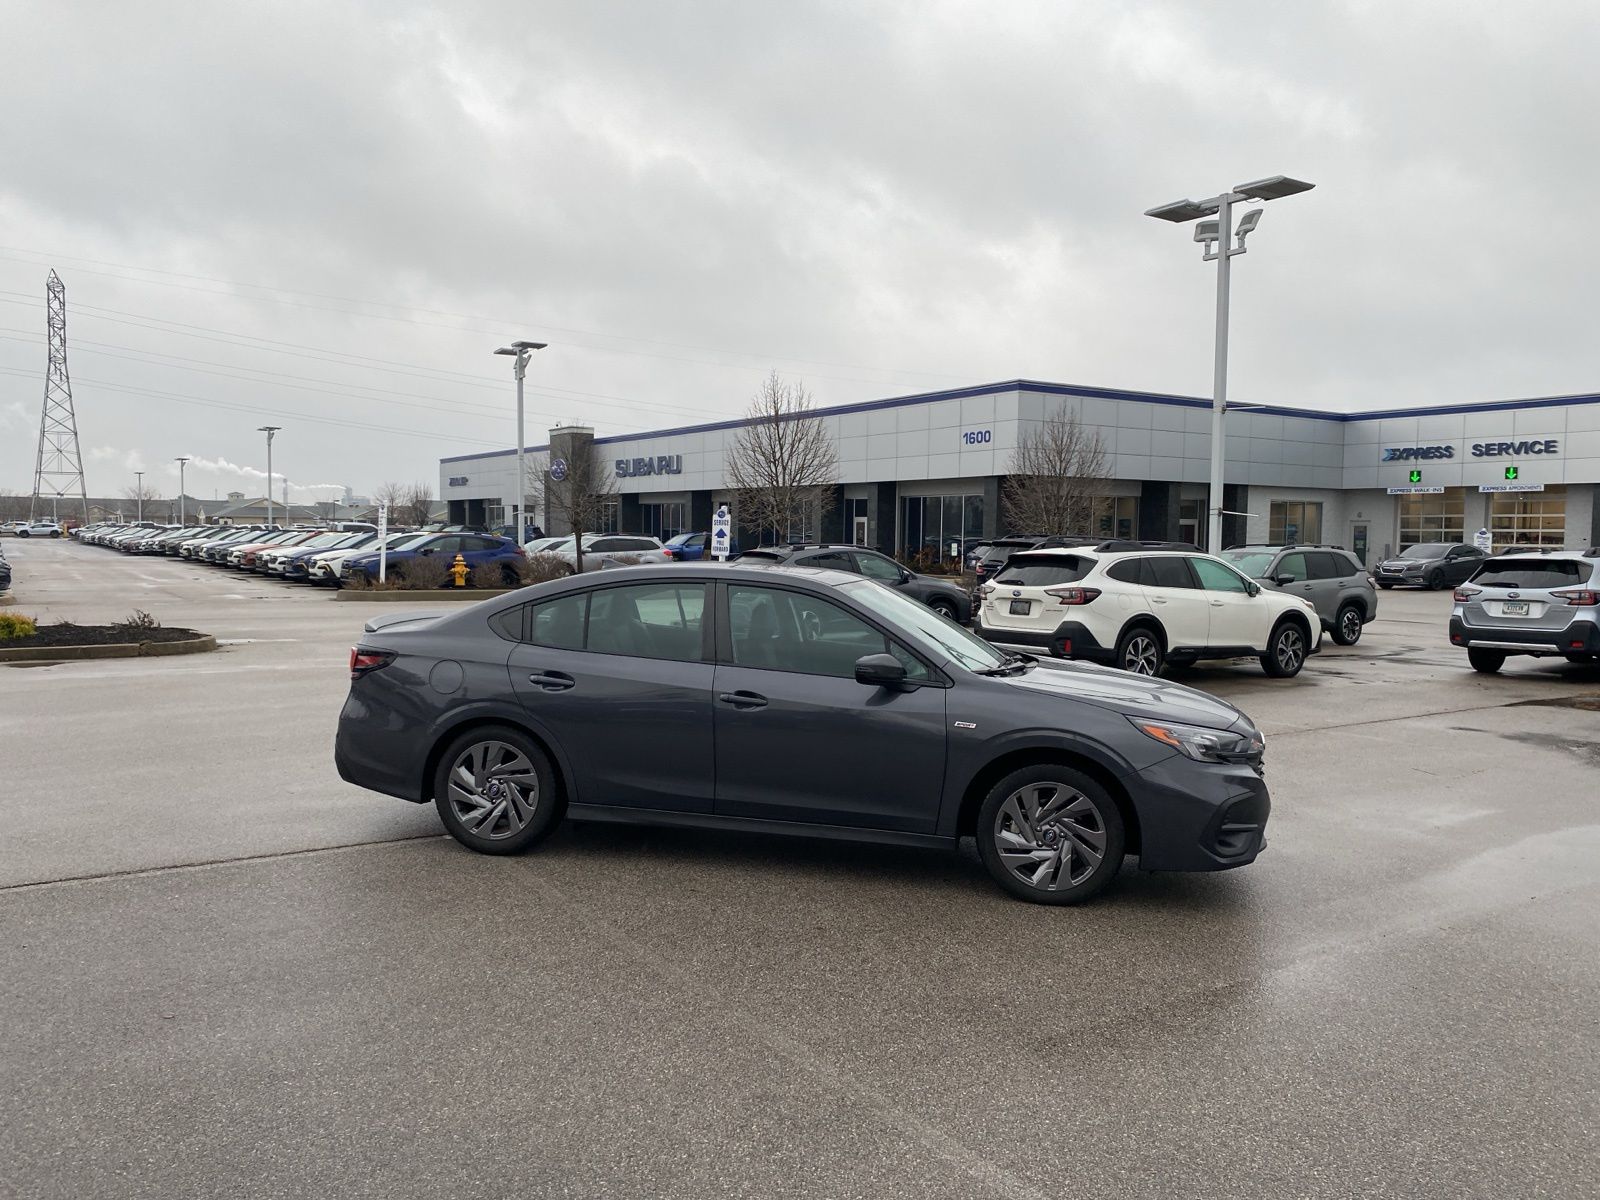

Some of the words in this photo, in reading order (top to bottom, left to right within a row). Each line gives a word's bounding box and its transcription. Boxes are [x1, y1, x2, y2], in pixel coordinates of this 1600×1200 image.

[963, 430, 991, 445] 1600
[1382, 445, 1455, 461] EXPRESS
[1471, 440, 1559, 457] SERVICE
[615, 455, 682, 478] SUBARU
